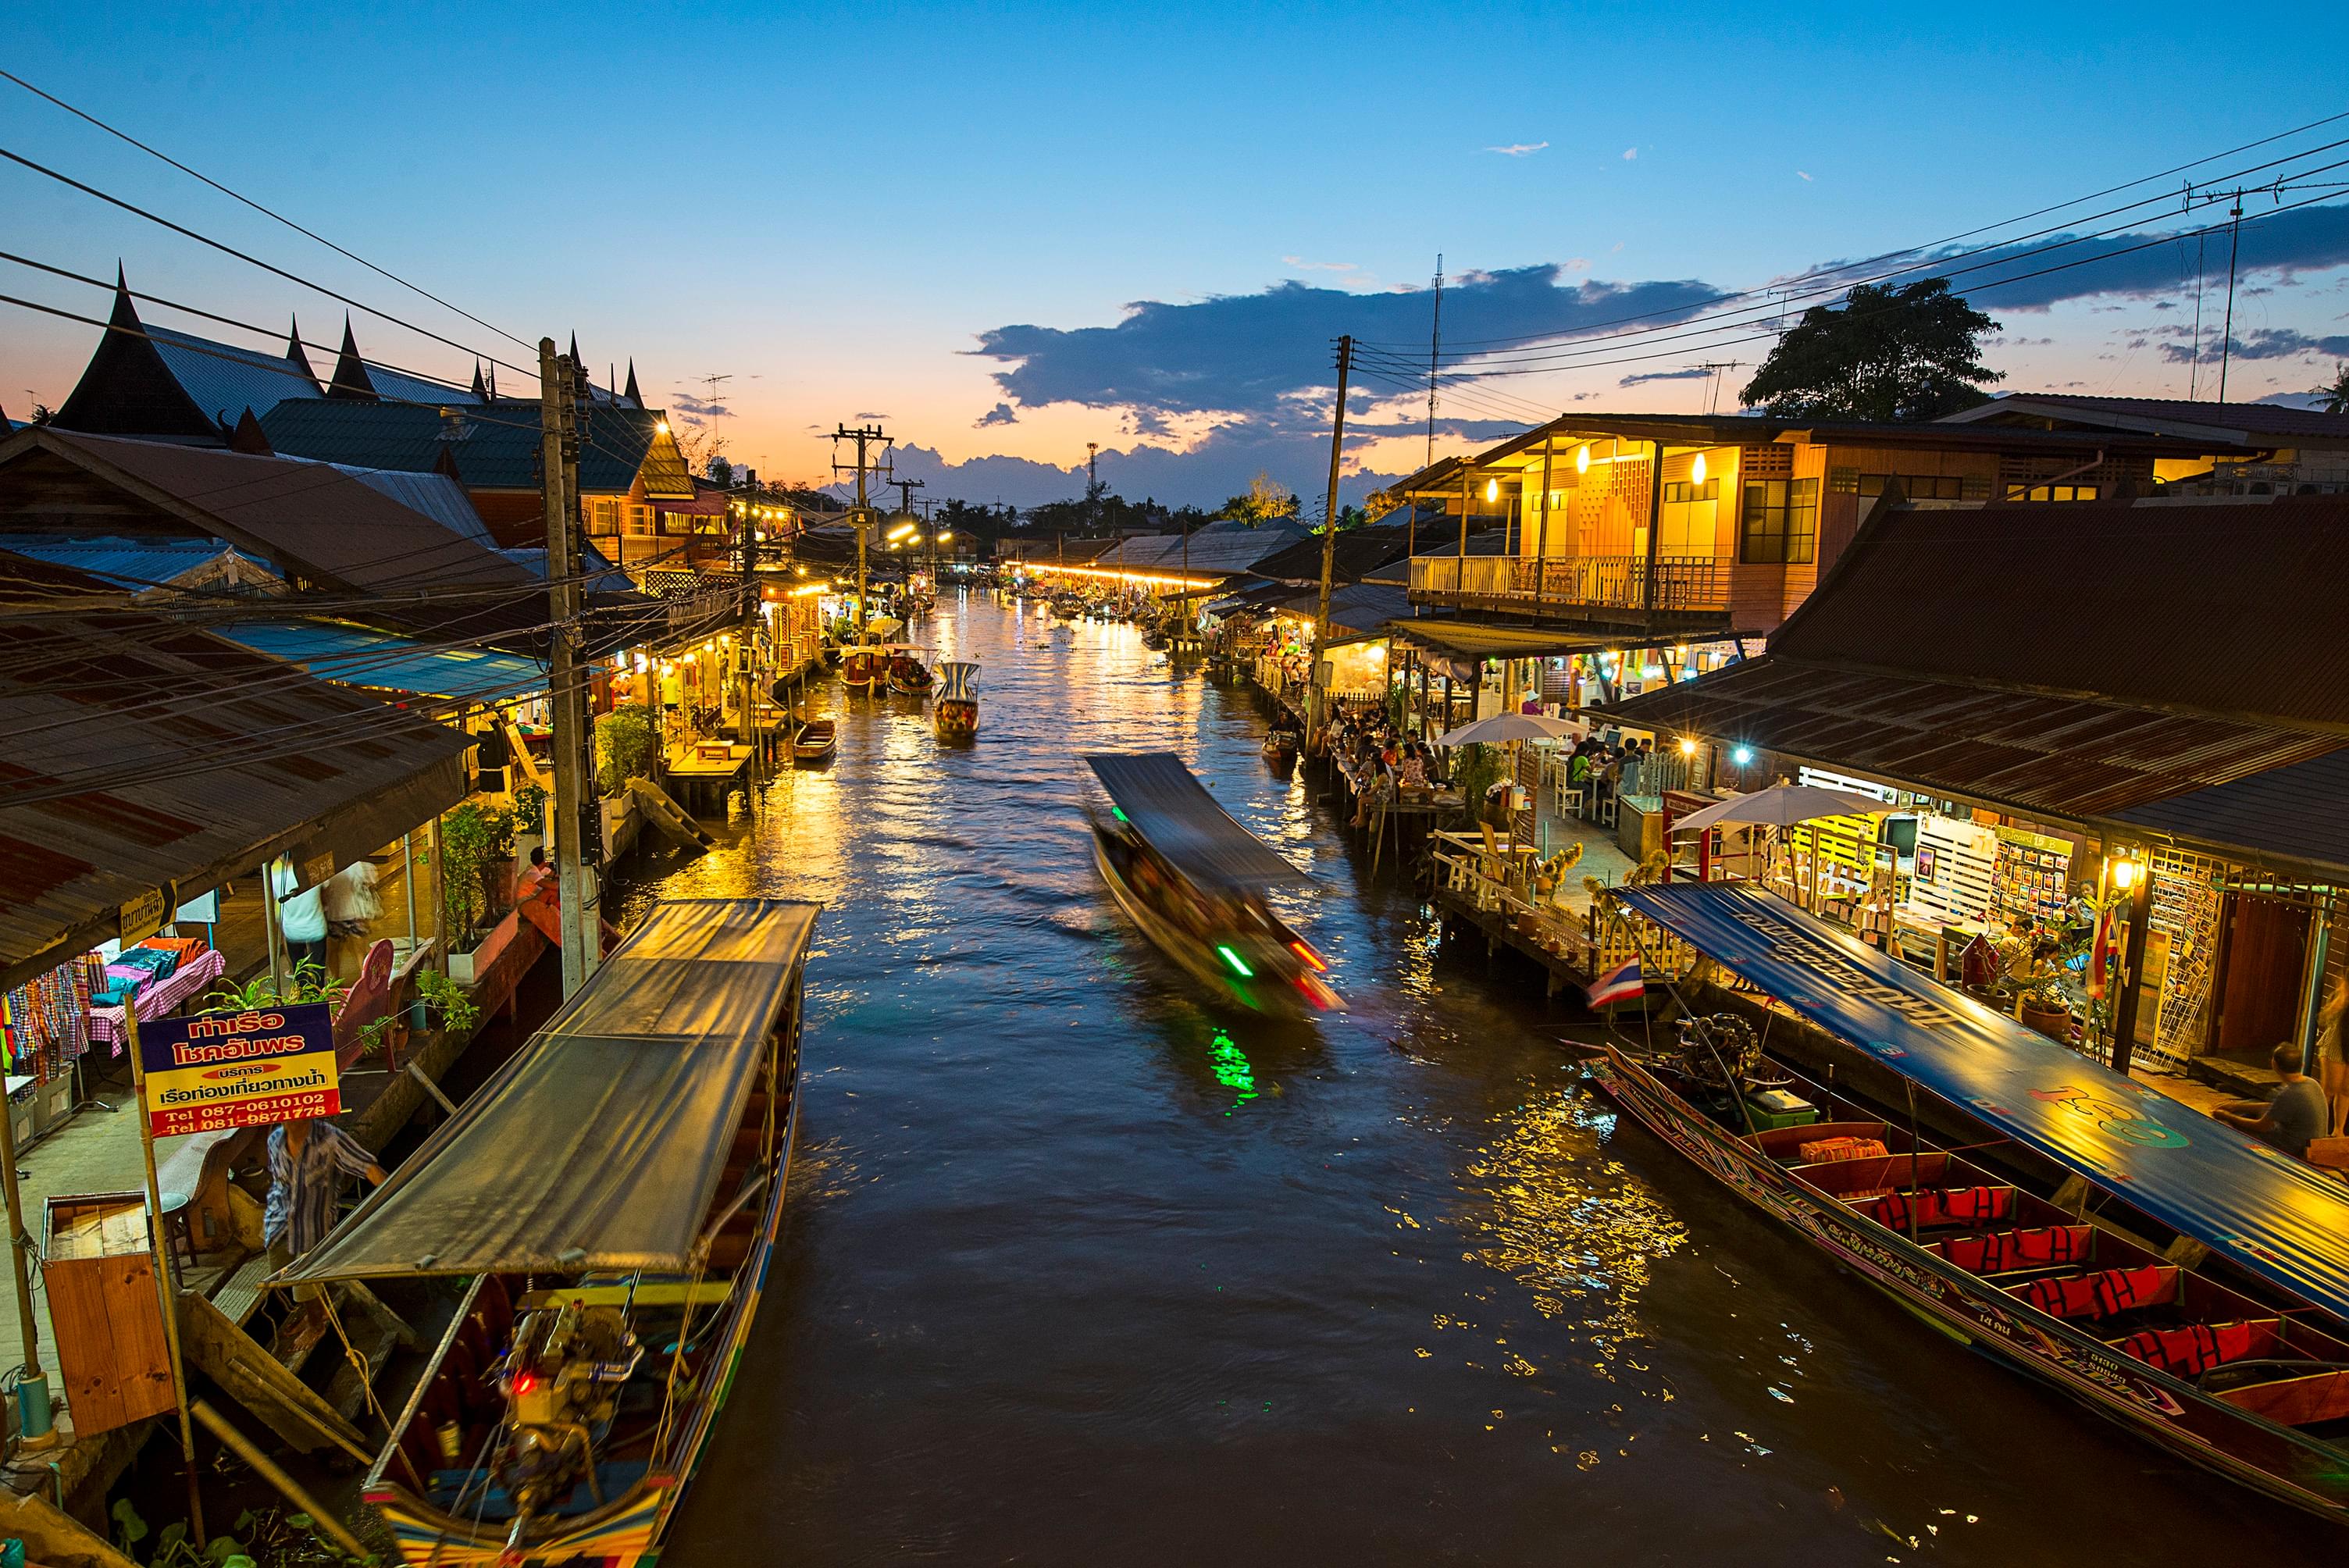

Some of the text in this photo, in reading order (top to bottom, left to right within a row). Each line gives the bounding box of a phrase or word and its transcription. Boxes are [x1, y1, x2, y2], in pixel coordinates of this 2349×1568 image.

[2000, 828, 2033, 843] Postcard
[2034, 836, 2045, 846] 15
[188, 1010, 285, 1039] ท่าเรือ
[172, 1035, 305, 1065] โชคอัมพร
[219, 1064, 263, 1079] บริการ
[159, 1069, 327, 1104] เรือท่องเที่ยวทางน้ำ
[166, 1094, 325, 1122] Tel 087-0610102
[202, 1106, 326, 1131] 081-9871778
